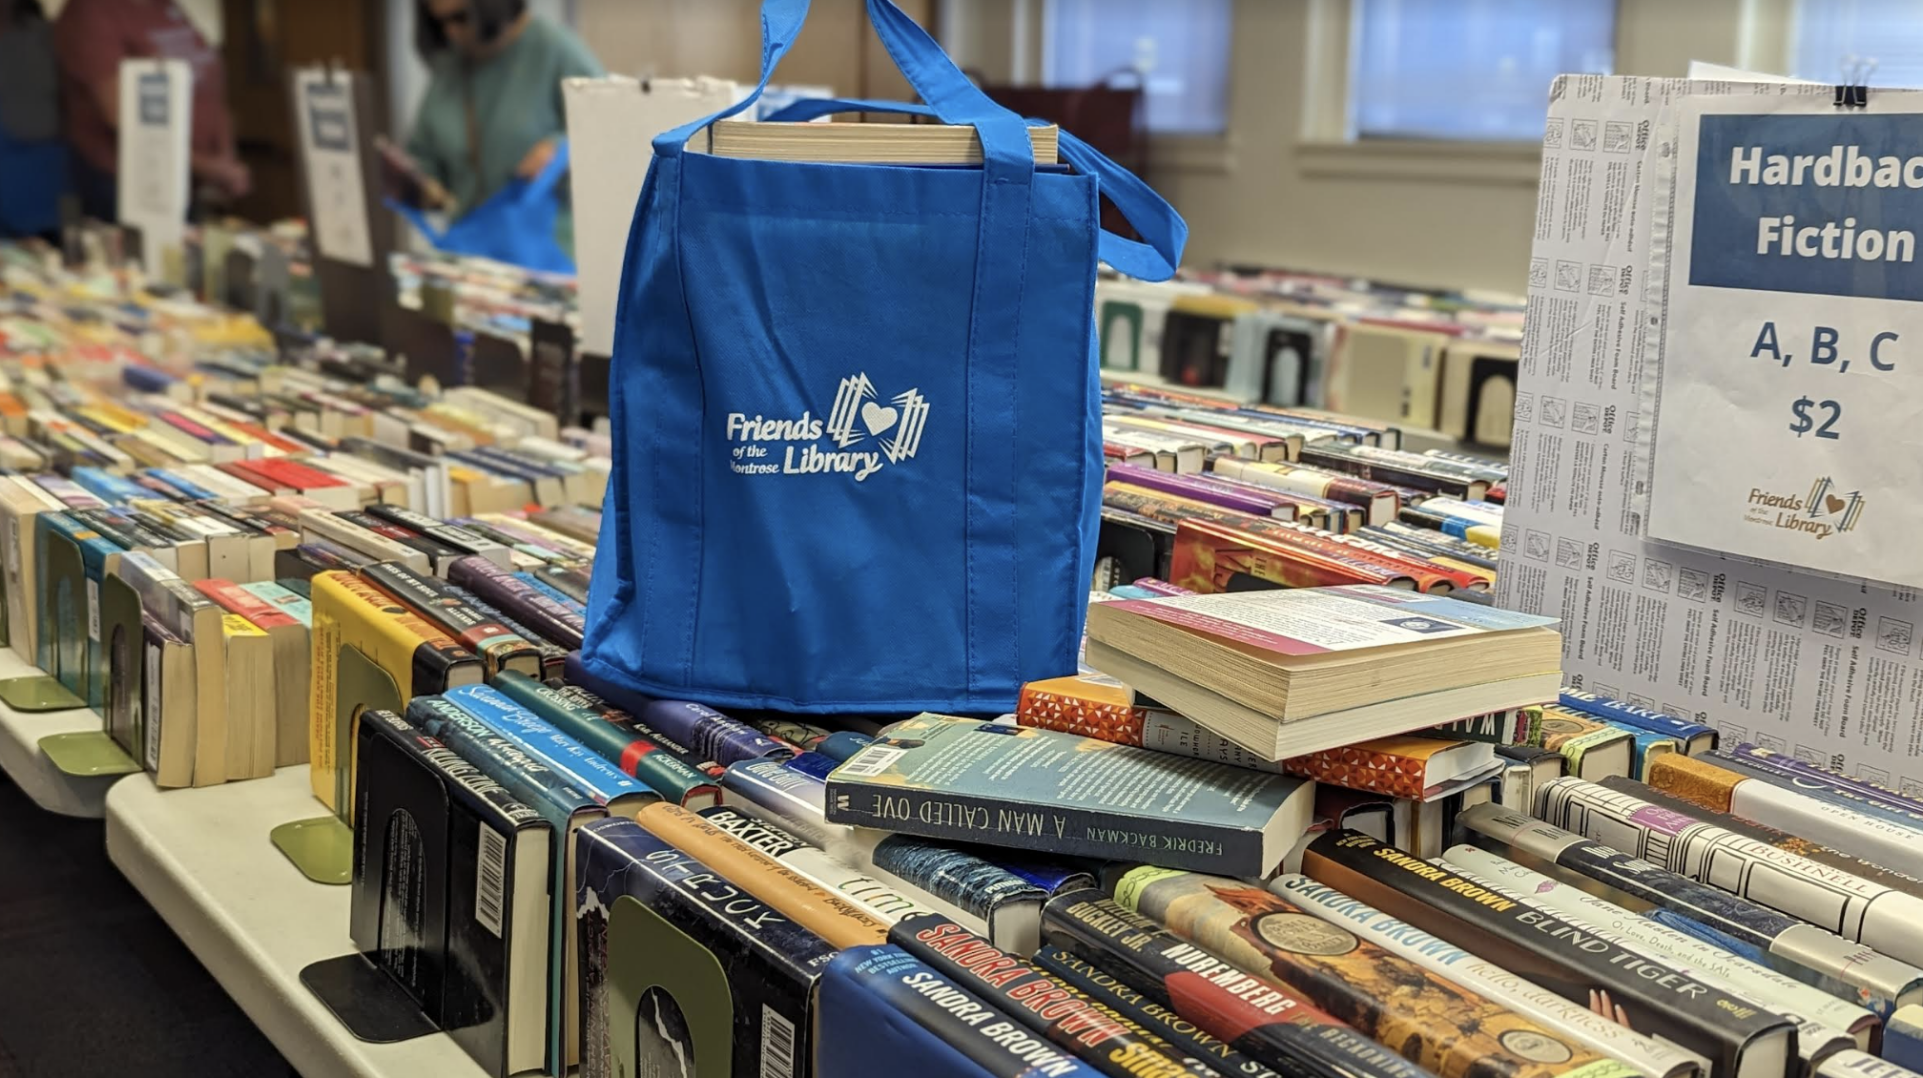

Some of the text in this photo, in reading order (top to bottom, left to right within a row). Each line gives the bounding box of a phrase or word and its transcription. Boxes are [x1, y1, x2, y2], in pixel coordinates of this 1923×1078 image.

[1757, 215, 1915, 262] Fiction
[1750, 321, 1900, 374] A, B, C
[727, 411, 824, 442] Friends
[1789, 395, 1841, 440] $2
[733, 445, 769, 459] of the
[783, 444, 884, 482] Library
[1748, 488, 1803, 511] Friends
[1775, 512, 1833, 540] Library
[1717, 573, 1726, 603] Office
[1856, 607, 1867, 639] Office
[427, 699, 495, 738] ANDERSON
[706, 809, 794, 858] BAXTER
[872, 793, 1066, 839] A MAN CALLED OVE
[1821, 805, 1915, 840] OPEN HOUSE
[1086, 827, 1223, 856] FREDRIK BACKMAN
[646, 848, 785, 930] STRUCK
[1750, 844, 1867, 893] BUSHNELL
[1066, 901, 1153, 953] BUCKLEY JR.
[1373, 847, 1447, 881] SANDRA
[1438, 876, 1518, 913] BROWN
[1515, 910, 1609, 953] BLIND
[1608, 950, 1708, 1000] TIGER
[1625, 923, 1646, 943] Love,
[1648, 936, 1675, 956] Death,
[1676, 950, 1693, 963] and
[1692, 952, 1708, 968] the
[1285, 877, 1381, 924] SANDRA
[1370, 919, 1474, 966] BROWN
[1521, 987, 1620, 1040] darkness
[1623, 914, 1688, 944] Austen
[1712, 949, 1799, 990] Scarsdale
[916, 923, 1033, 989] SANDRA
[1006, 979, 1132, 1047] BROWN
[1052, 950, 1144, 1006] SANDRA
[1140, 1003, 1238, 1060] BROWN
[902, 972, 995, 1027] SANDRA
[979, 1021, 1079, 1078] BROWN
[1160, 942, 1298, 1016] NUREMBERG
[1319, 1028, 1416, 1078] RECKONING
